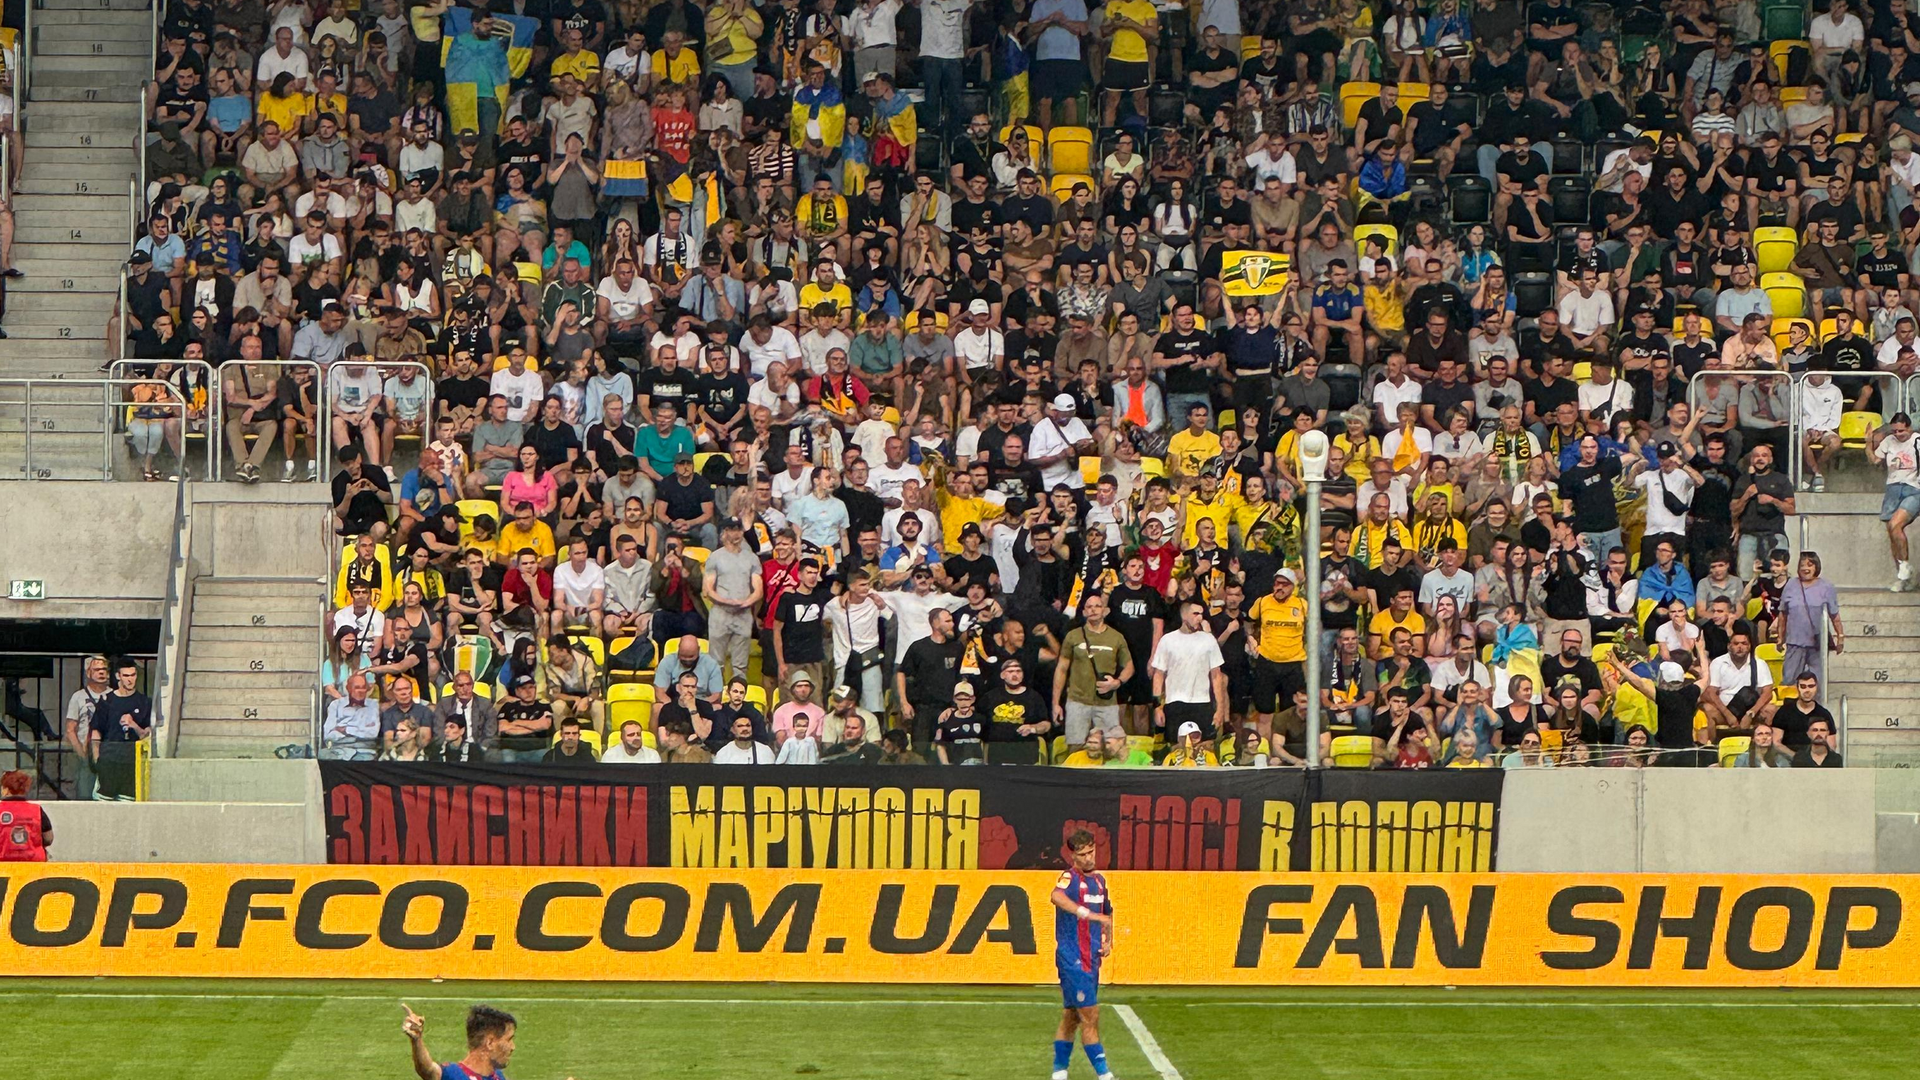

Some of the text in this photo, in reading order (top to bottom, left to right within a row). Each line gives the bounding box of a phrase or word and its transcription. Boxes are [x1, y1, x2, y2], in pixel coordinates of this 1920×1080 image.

[85, 89, 98, 99] 17
[70, 230, 82, 239] 14
[58, 327, 71, 337] 12
[249, 660, 265, 670] 05
[1874, 670, 1889, 682] 05
[243, 708, 258, 718] 04
[1885, 717, 1899, 727] 04
[331, 783, 648, 867] ЗАХИСНИКИ
[0, 876, 1903, 971] OP.FCO.COM.UA FAN SHOP
